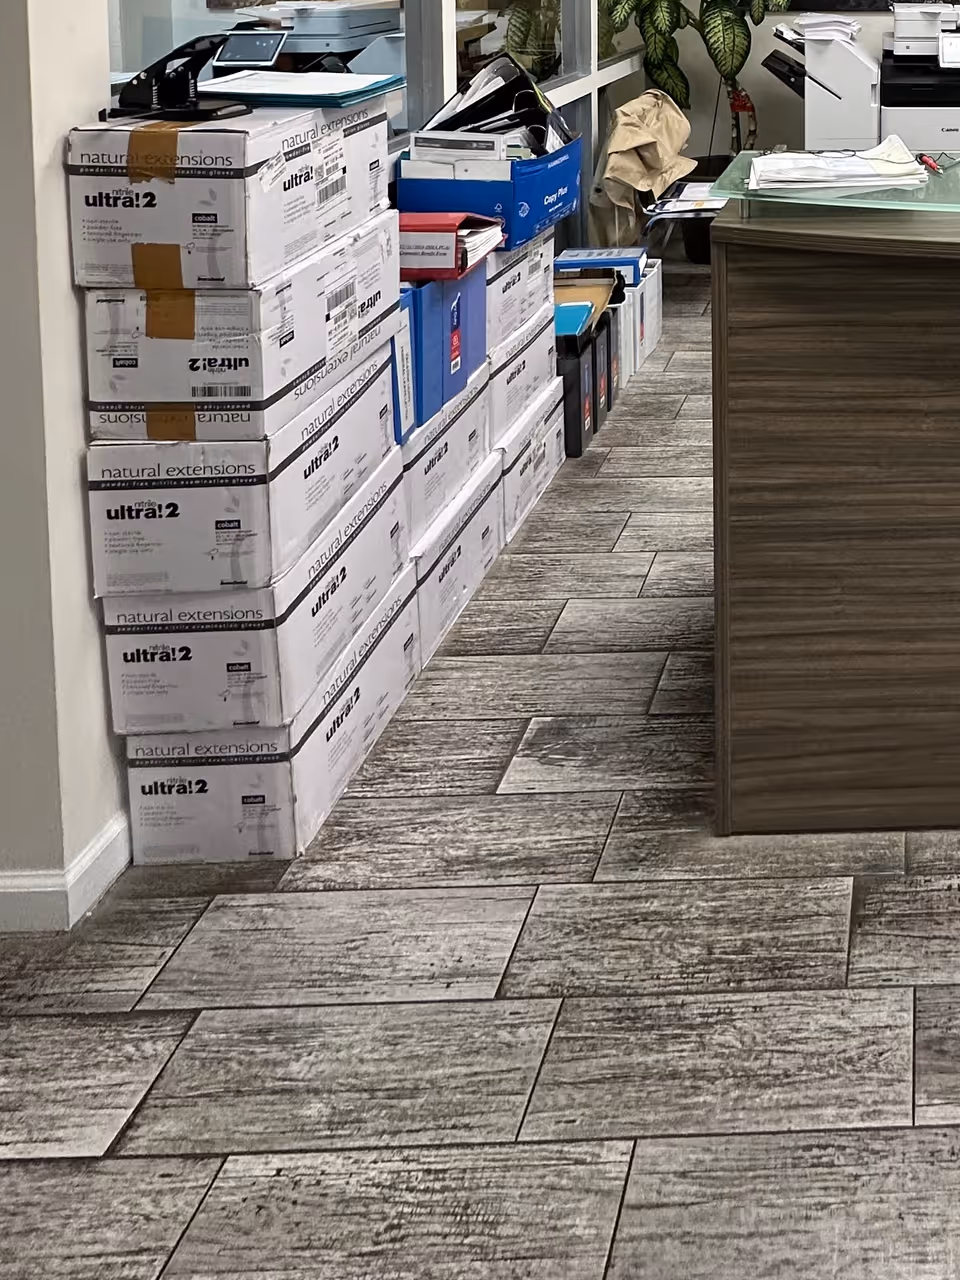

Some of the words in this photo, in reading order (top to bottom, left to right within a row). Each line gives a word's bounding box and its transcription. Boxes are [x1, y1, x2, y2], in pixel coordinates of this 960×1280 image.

[282, 123, 318, 151] natural
[321, 108, 368, 136] extensions
[543, 191, 558, 206] Copy
[557, 185, 569, 198] Plus
[350, 325, 381, 355] natural
[294, 348, 349, 400] extensions
[301, 397, 336, 440] natural
[337, 360, 378, 407] extensions
[197, 412, 250, 423] natura
[101, 463, 161, 478] natural
[166, 460, 256, 477] extensions
[308, 528, 343, 579] natural
[344, 481, 388, 537] extensions
[117, 608, 173, 624] natural
[178, 605, 263, 622] extensions
[323, 650, 357, 705] natural
[358, 596, 402, 657] extensions
[135, 742, 189, 757] natural
[194, 739, 278, 754] extensions
